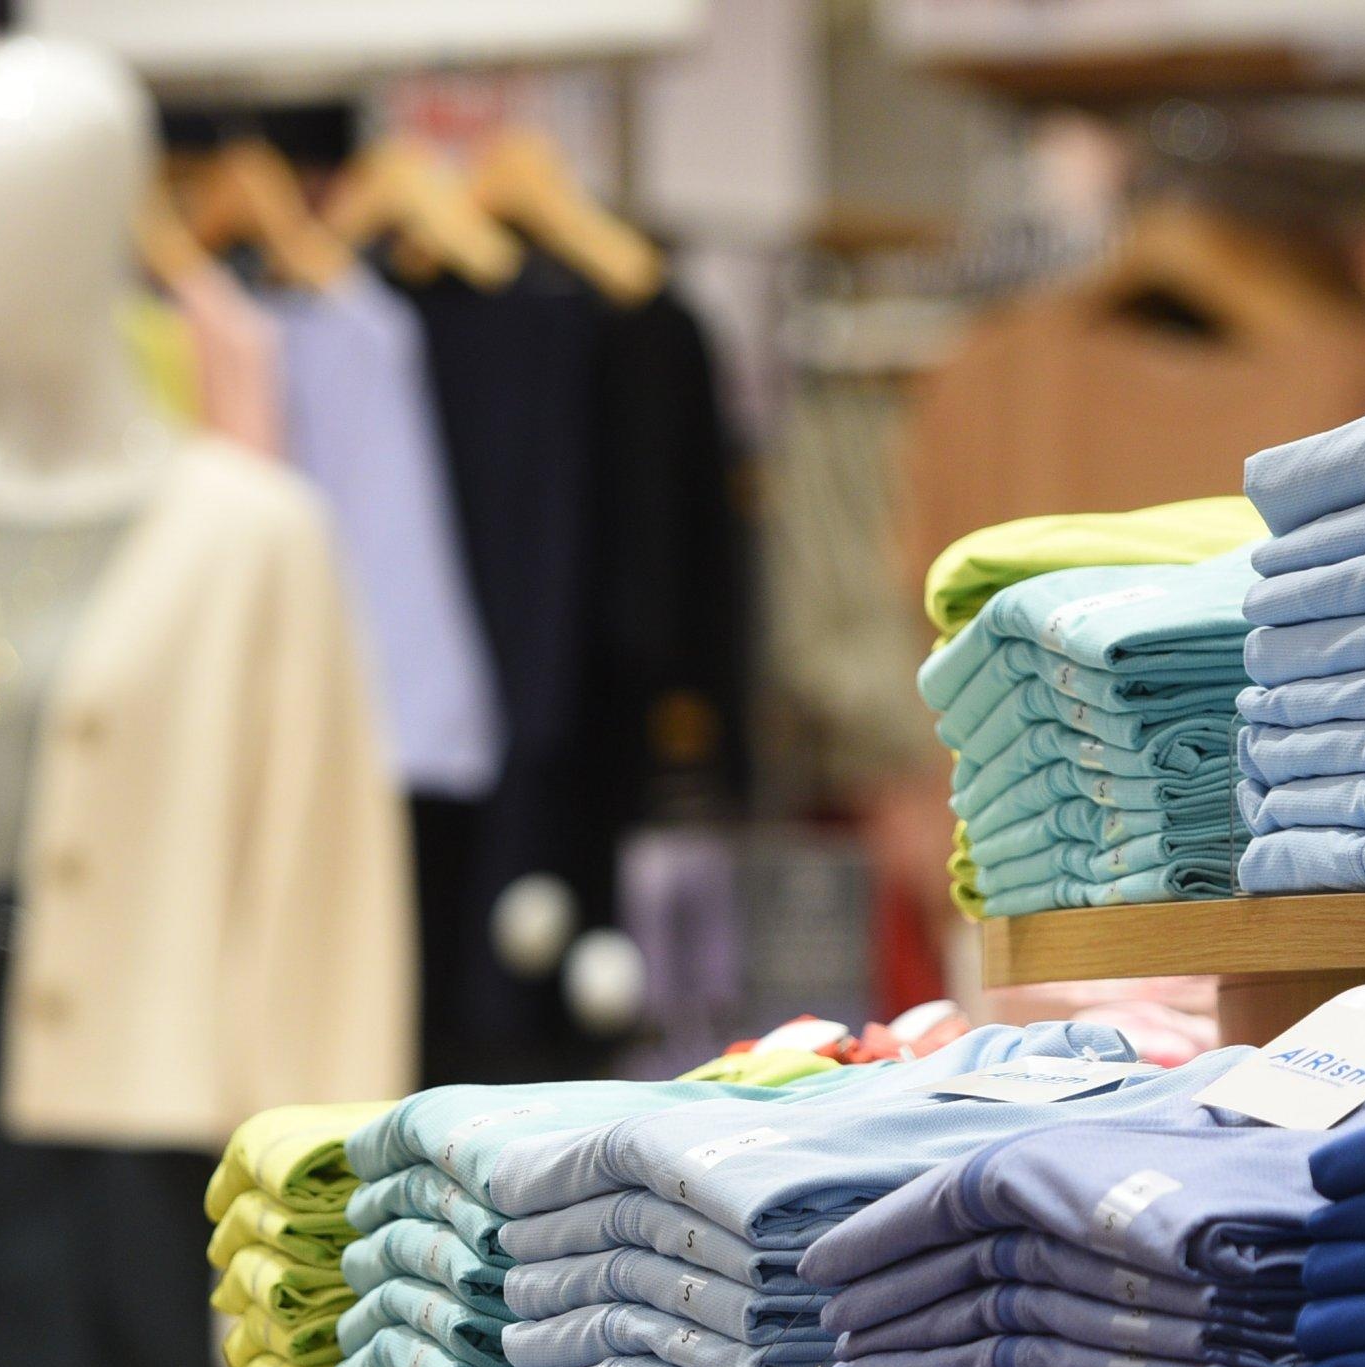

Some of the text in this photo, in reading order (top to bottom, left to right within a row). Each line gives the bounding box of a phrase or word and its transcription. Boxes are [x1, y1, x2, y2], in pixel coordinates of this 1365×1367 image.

[445, 1144, 454, 1160] S
[679, 1180, 686, 1198] S
[1105, 1212, 1117, 1230] S
[687, 1229, 695, 1248] S
[684, 1284, 692, 1301] S
[1126, 1281, 1134, 1299] S
[682, 1329, 696, 1343] S
